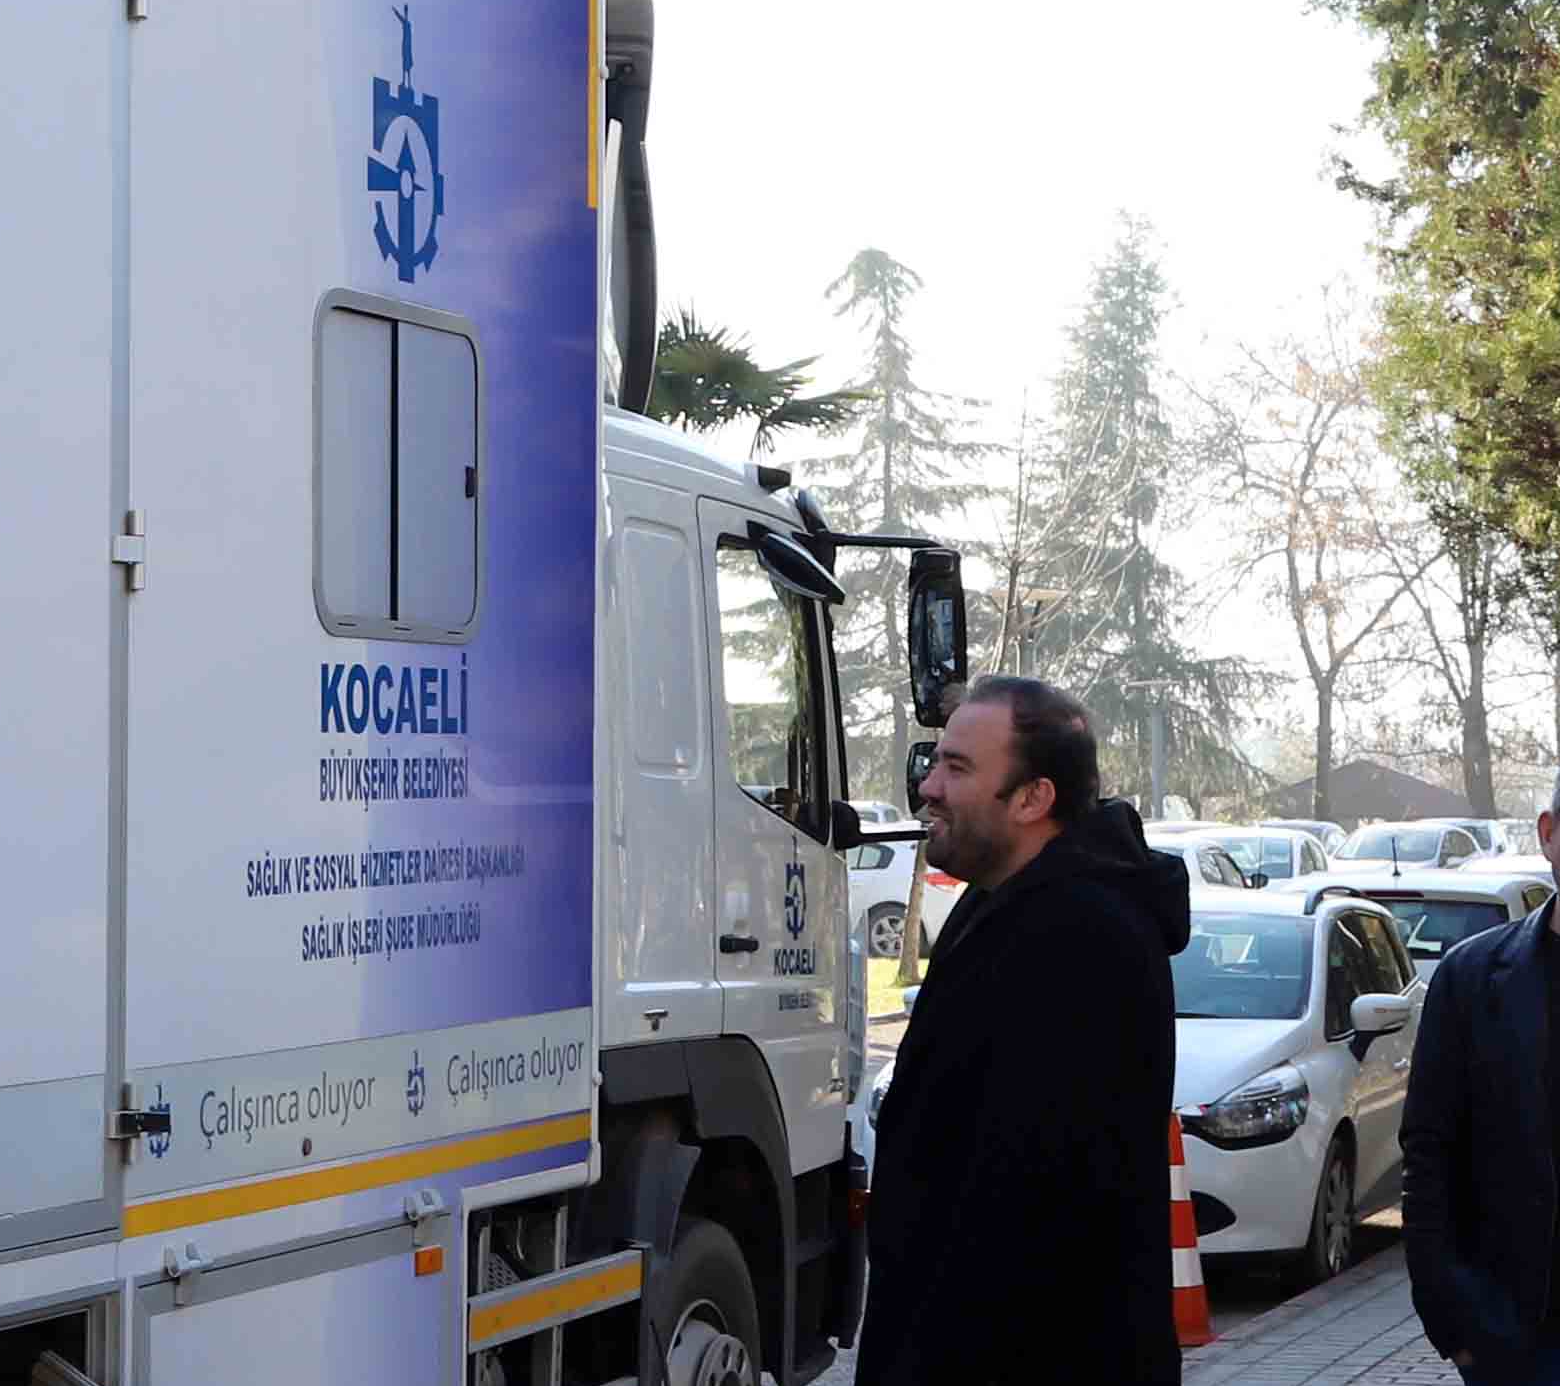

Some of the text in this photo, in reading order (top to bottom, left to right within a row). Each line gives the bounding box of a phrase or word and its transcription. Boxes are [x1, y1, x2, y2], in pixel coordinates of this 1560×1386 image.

[319, 652, 468, 735] KOCAELİ
[319, 745, 469, 813] BÜYÜKŞEHİR BELEDİYESİ
[246, 850, 292, 898] SAĞLIK
[295, 856, 311, 894] VE
[313, 854, 358, 892] SOSYAL
[360, 844, 423, 889] HİZMETLER
[301, 915, 345, 962] SAĞLIK
[347, 910, 383, 965] İŞLERİ
[385, 914, 415, 962] ŞUBE
[773, 940, 817, 977] KOCAELİ
[446, 1036, 585, 1108] Çalışınca oluyor
[199, 1071, 376, 1151] Çalışınca oluyor
